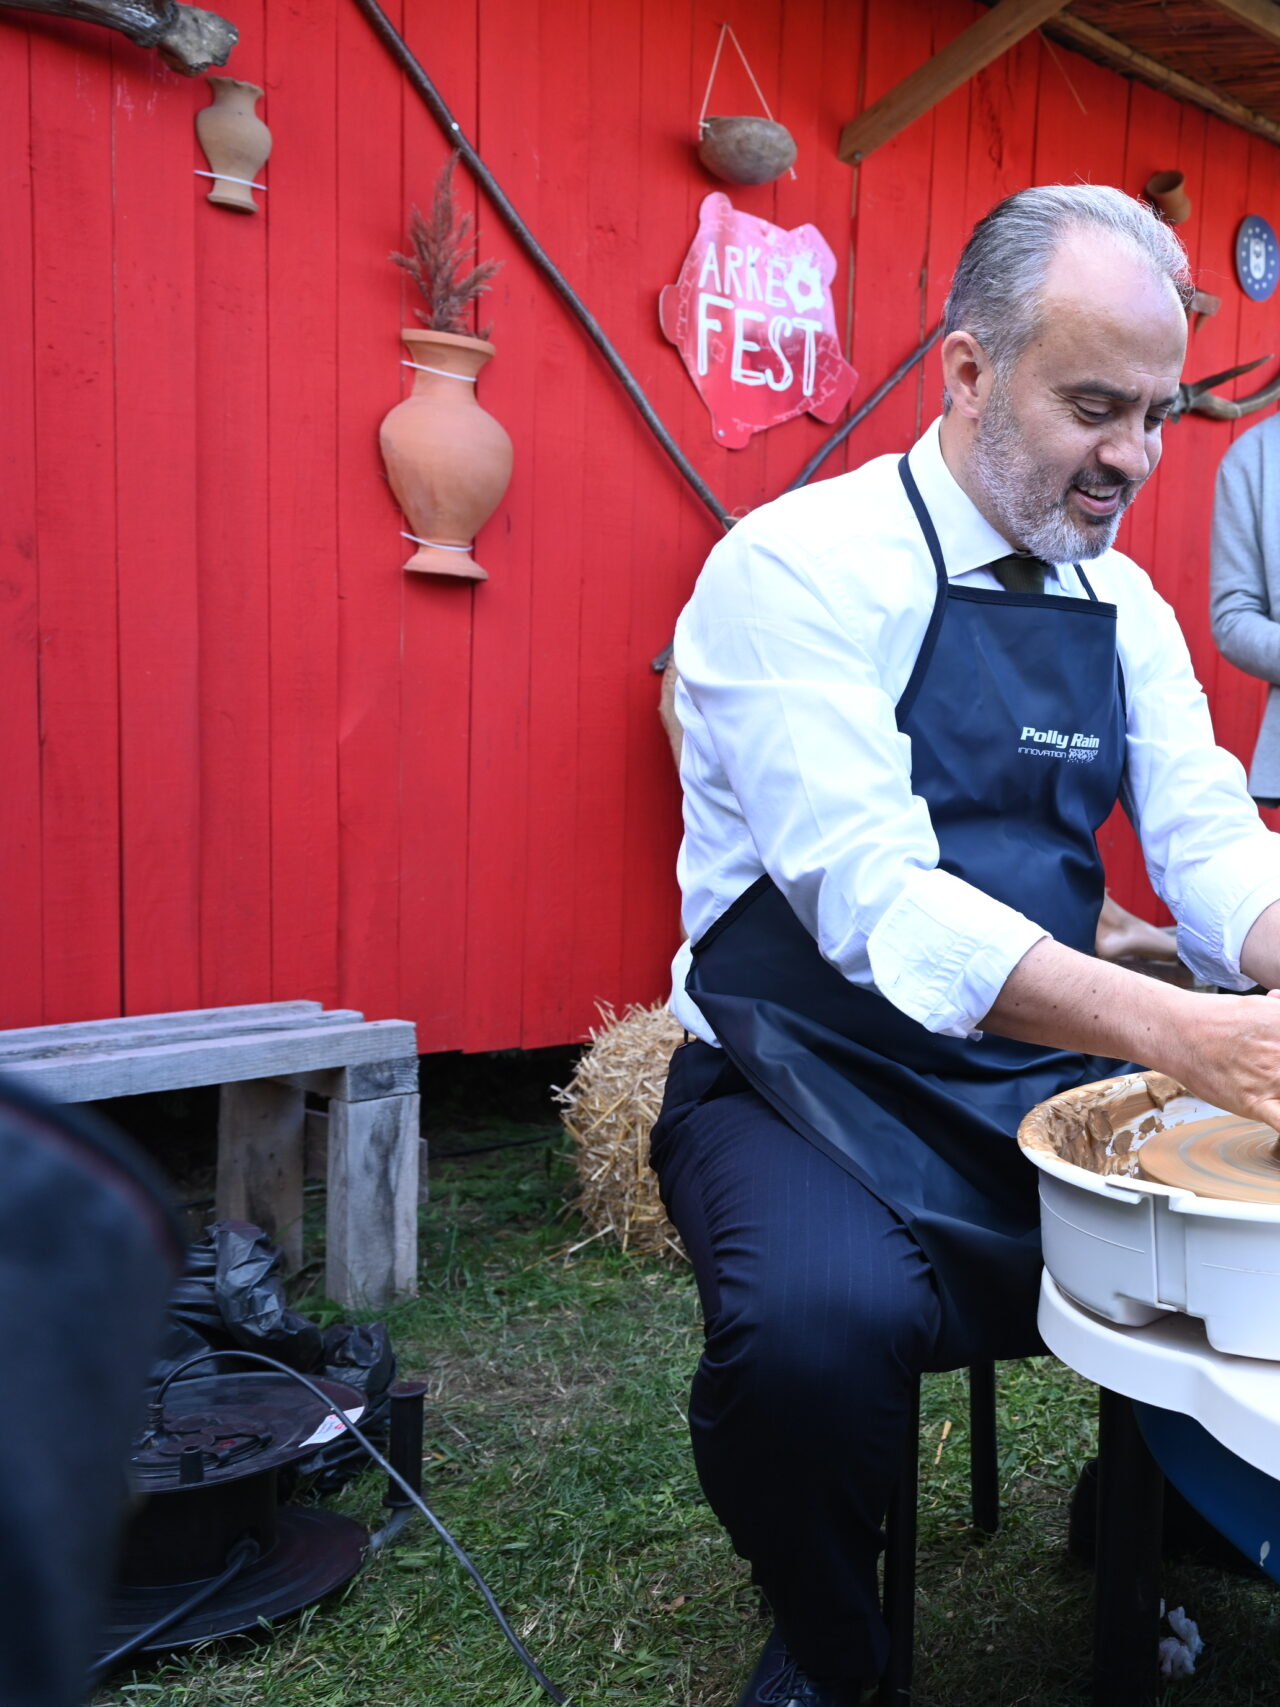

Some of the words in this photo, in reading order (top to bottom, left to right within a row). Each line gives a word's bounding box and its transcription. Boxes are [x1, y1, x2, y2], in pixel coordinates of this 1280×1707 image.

[697, 292, 823, 397] FEST
[1020, 726, 1069, 749] Polly
[1070, 732, 1100, 748] Rain
